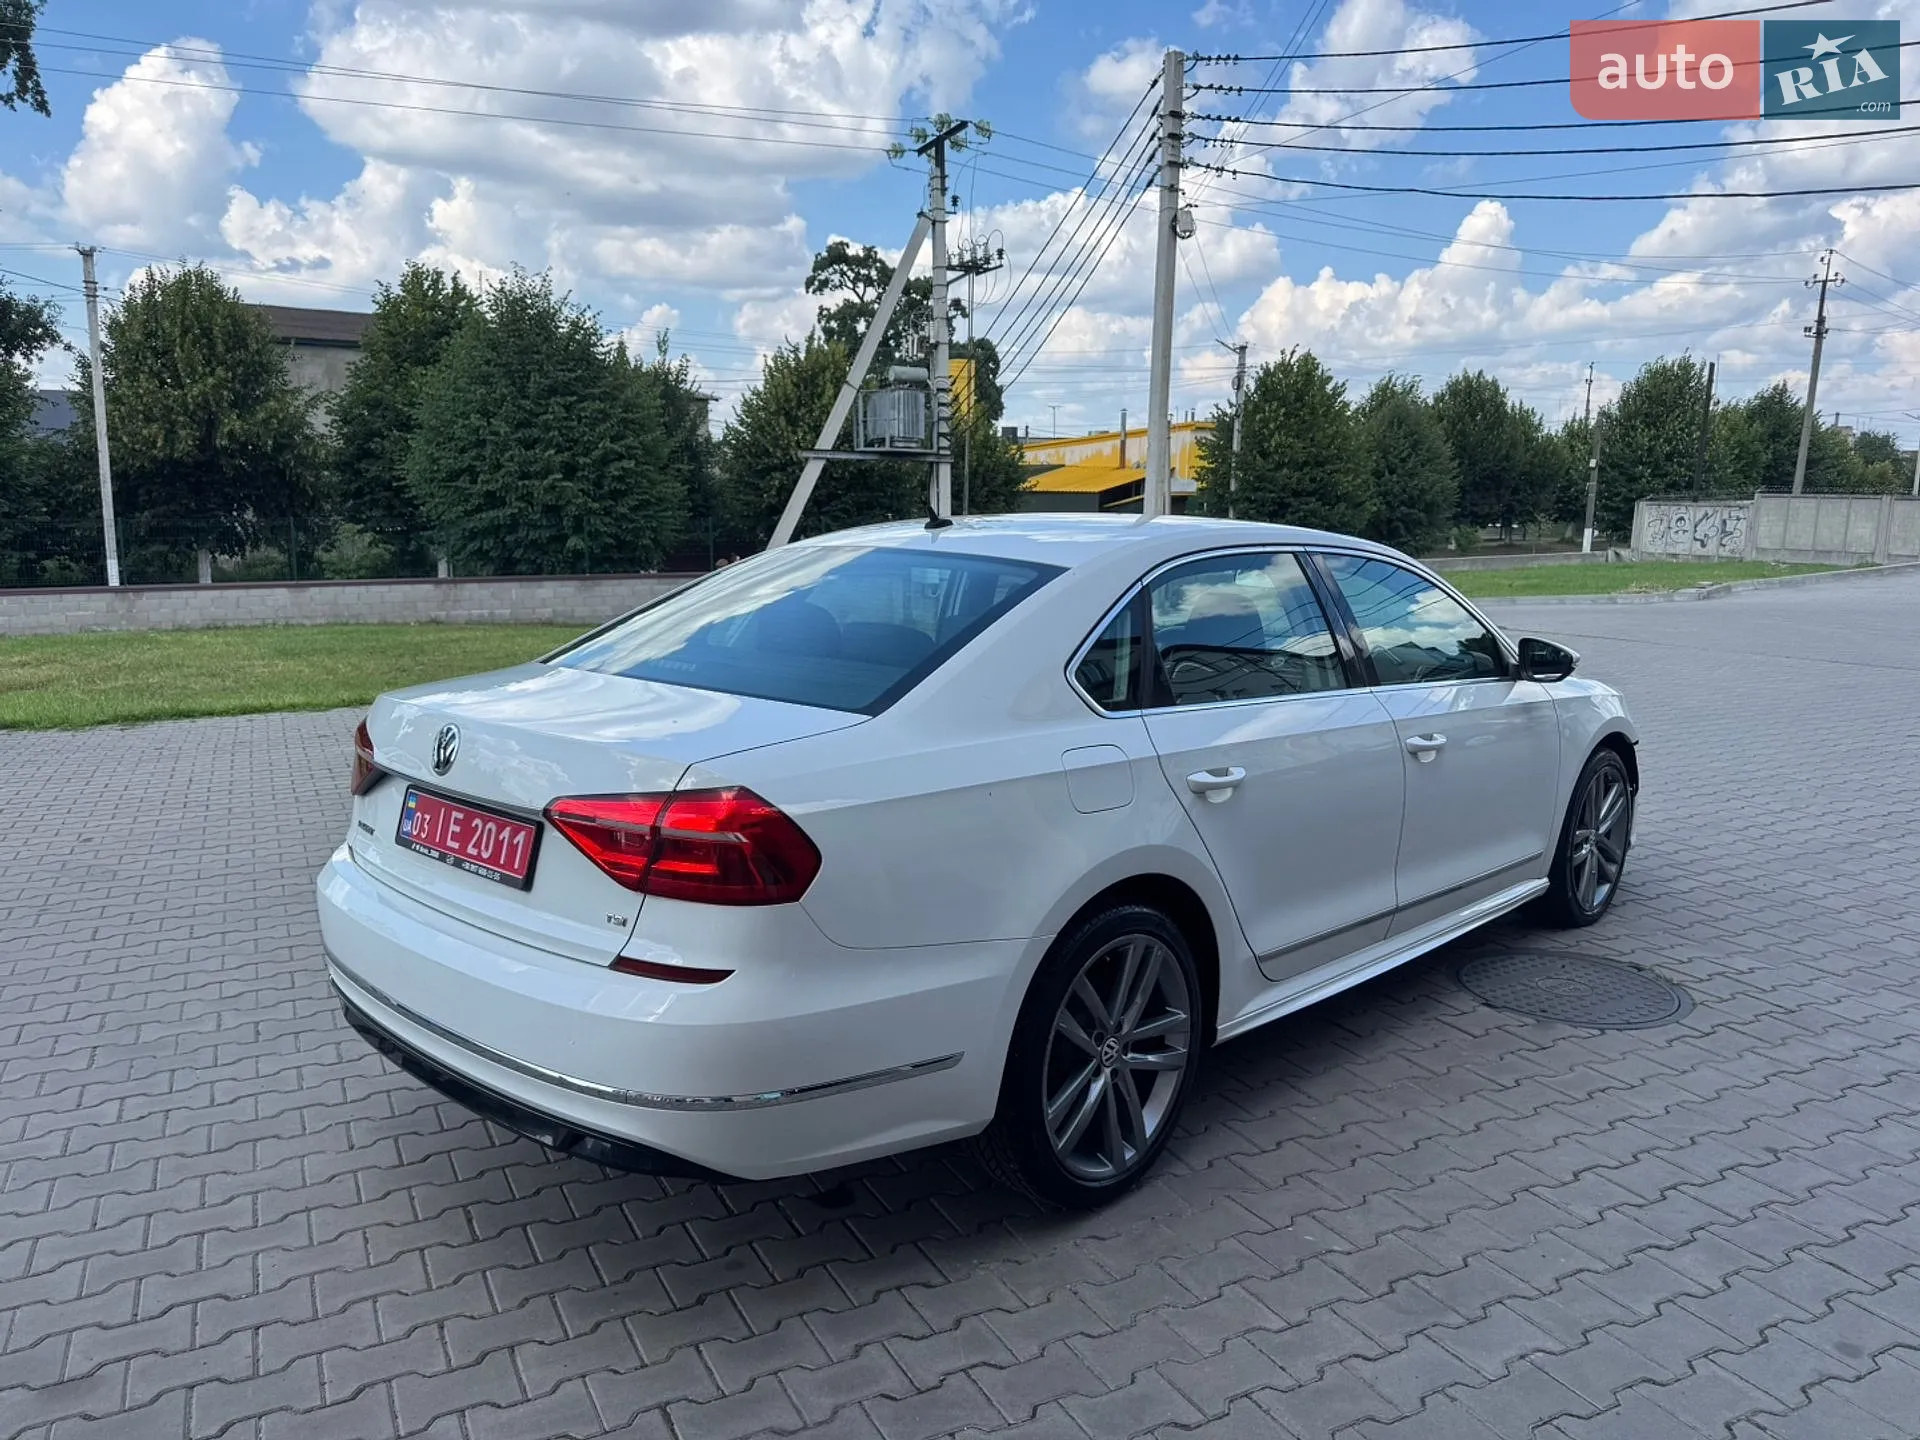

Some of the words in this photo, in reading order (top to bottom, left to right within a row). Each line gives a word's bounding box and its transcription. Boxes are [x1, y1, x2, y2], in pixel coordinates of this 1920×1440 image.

[403, 819, 412, 833] UA
[412, 811, 431, 838] 03
[466, 817, 527, 870] 2011
